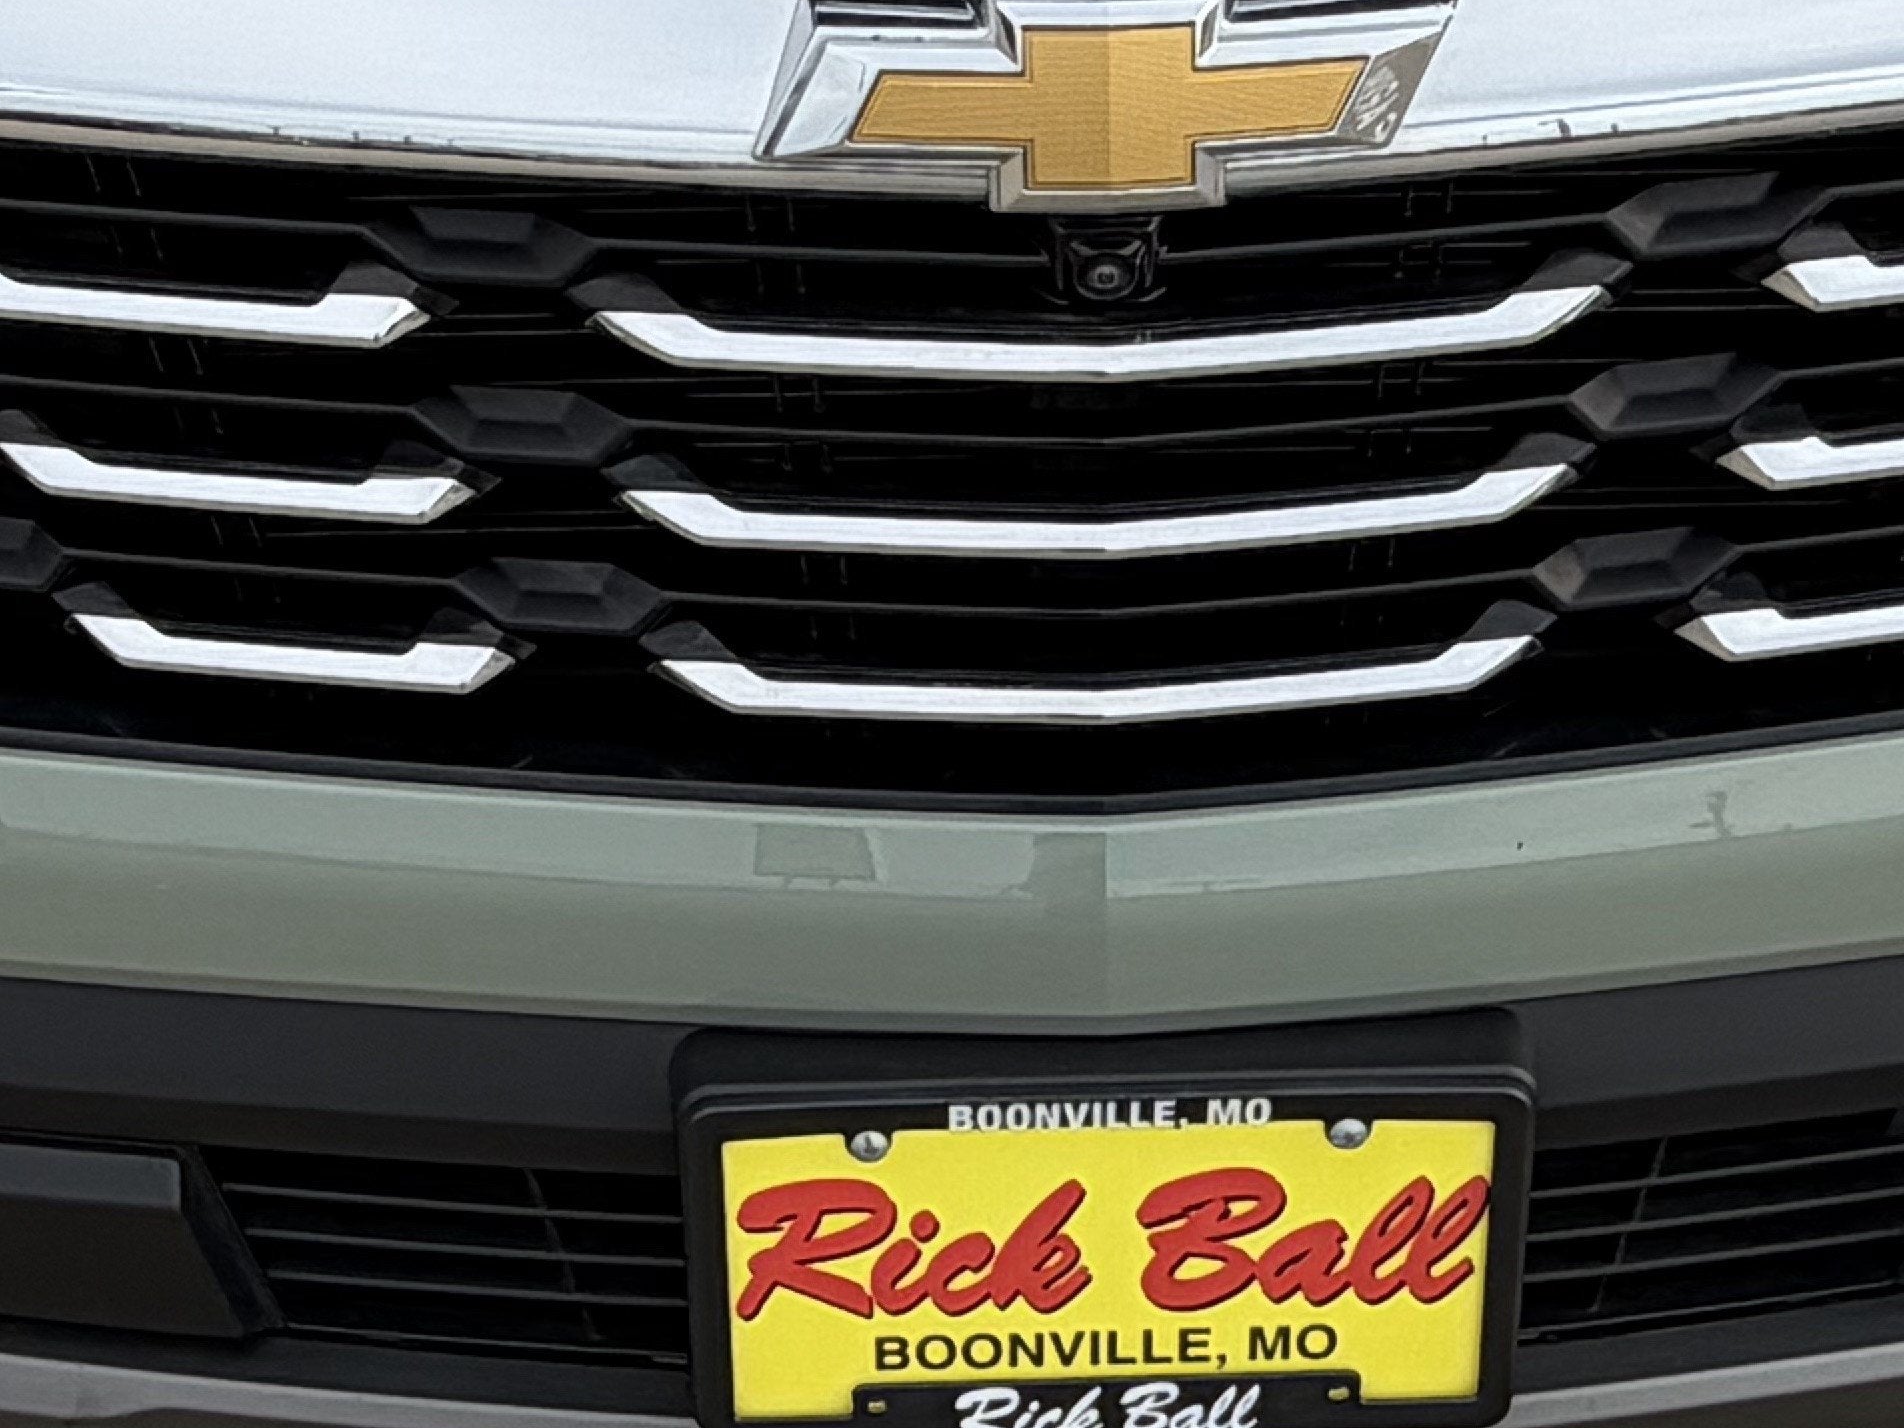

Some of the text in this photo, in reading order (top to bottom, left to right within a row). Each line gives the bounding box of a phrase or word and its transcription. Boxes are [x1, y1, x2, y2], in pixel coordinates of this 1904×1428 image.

[947, 1097, 1273, 1133] BOONVILLE, MO
[734, 1166, 1492, 1322] Rick Ball
[873, 1323, 1339, 1372] BOONVILLE, MO
